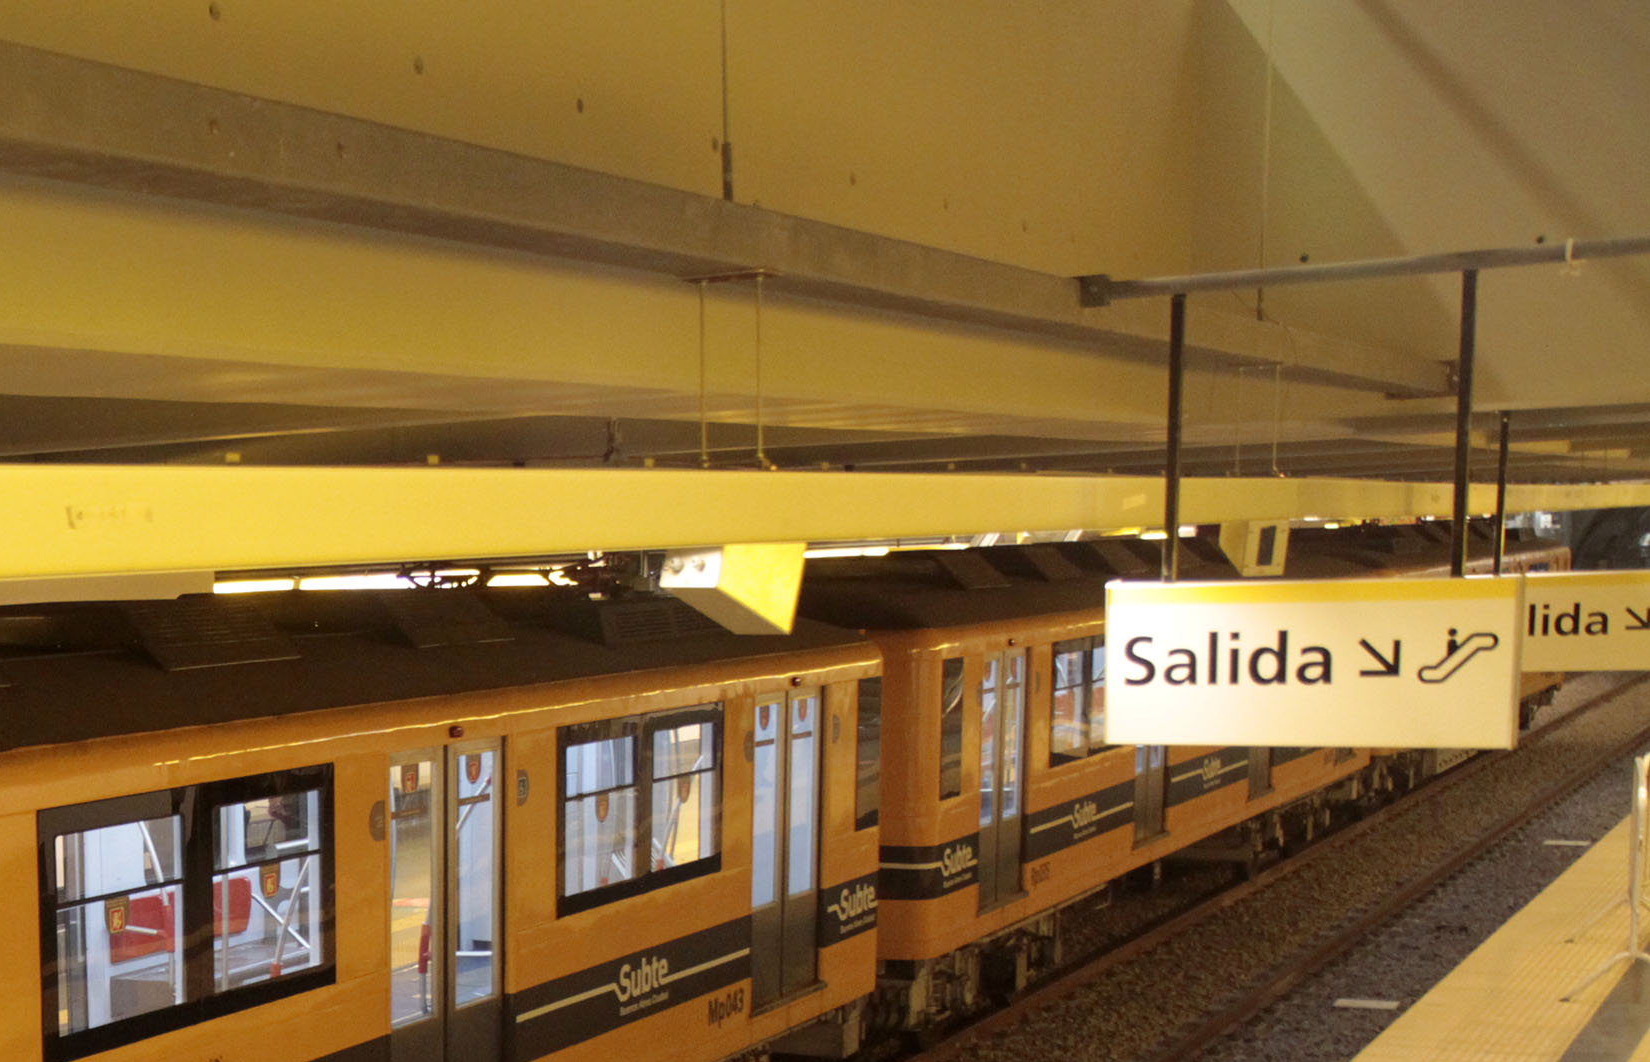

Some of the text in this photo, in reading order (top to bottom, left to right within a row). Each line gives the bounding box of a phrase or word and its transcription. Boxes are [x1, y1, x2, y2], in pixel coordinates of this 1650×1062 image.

[1526, 602, 1610, 637] lida
[1123, 629, 1333, 686] Salida
[942, 844, 975, 877] Subte
[839, 883, 878, 921] Subte
[618, 956, 669, 1002] Subte
